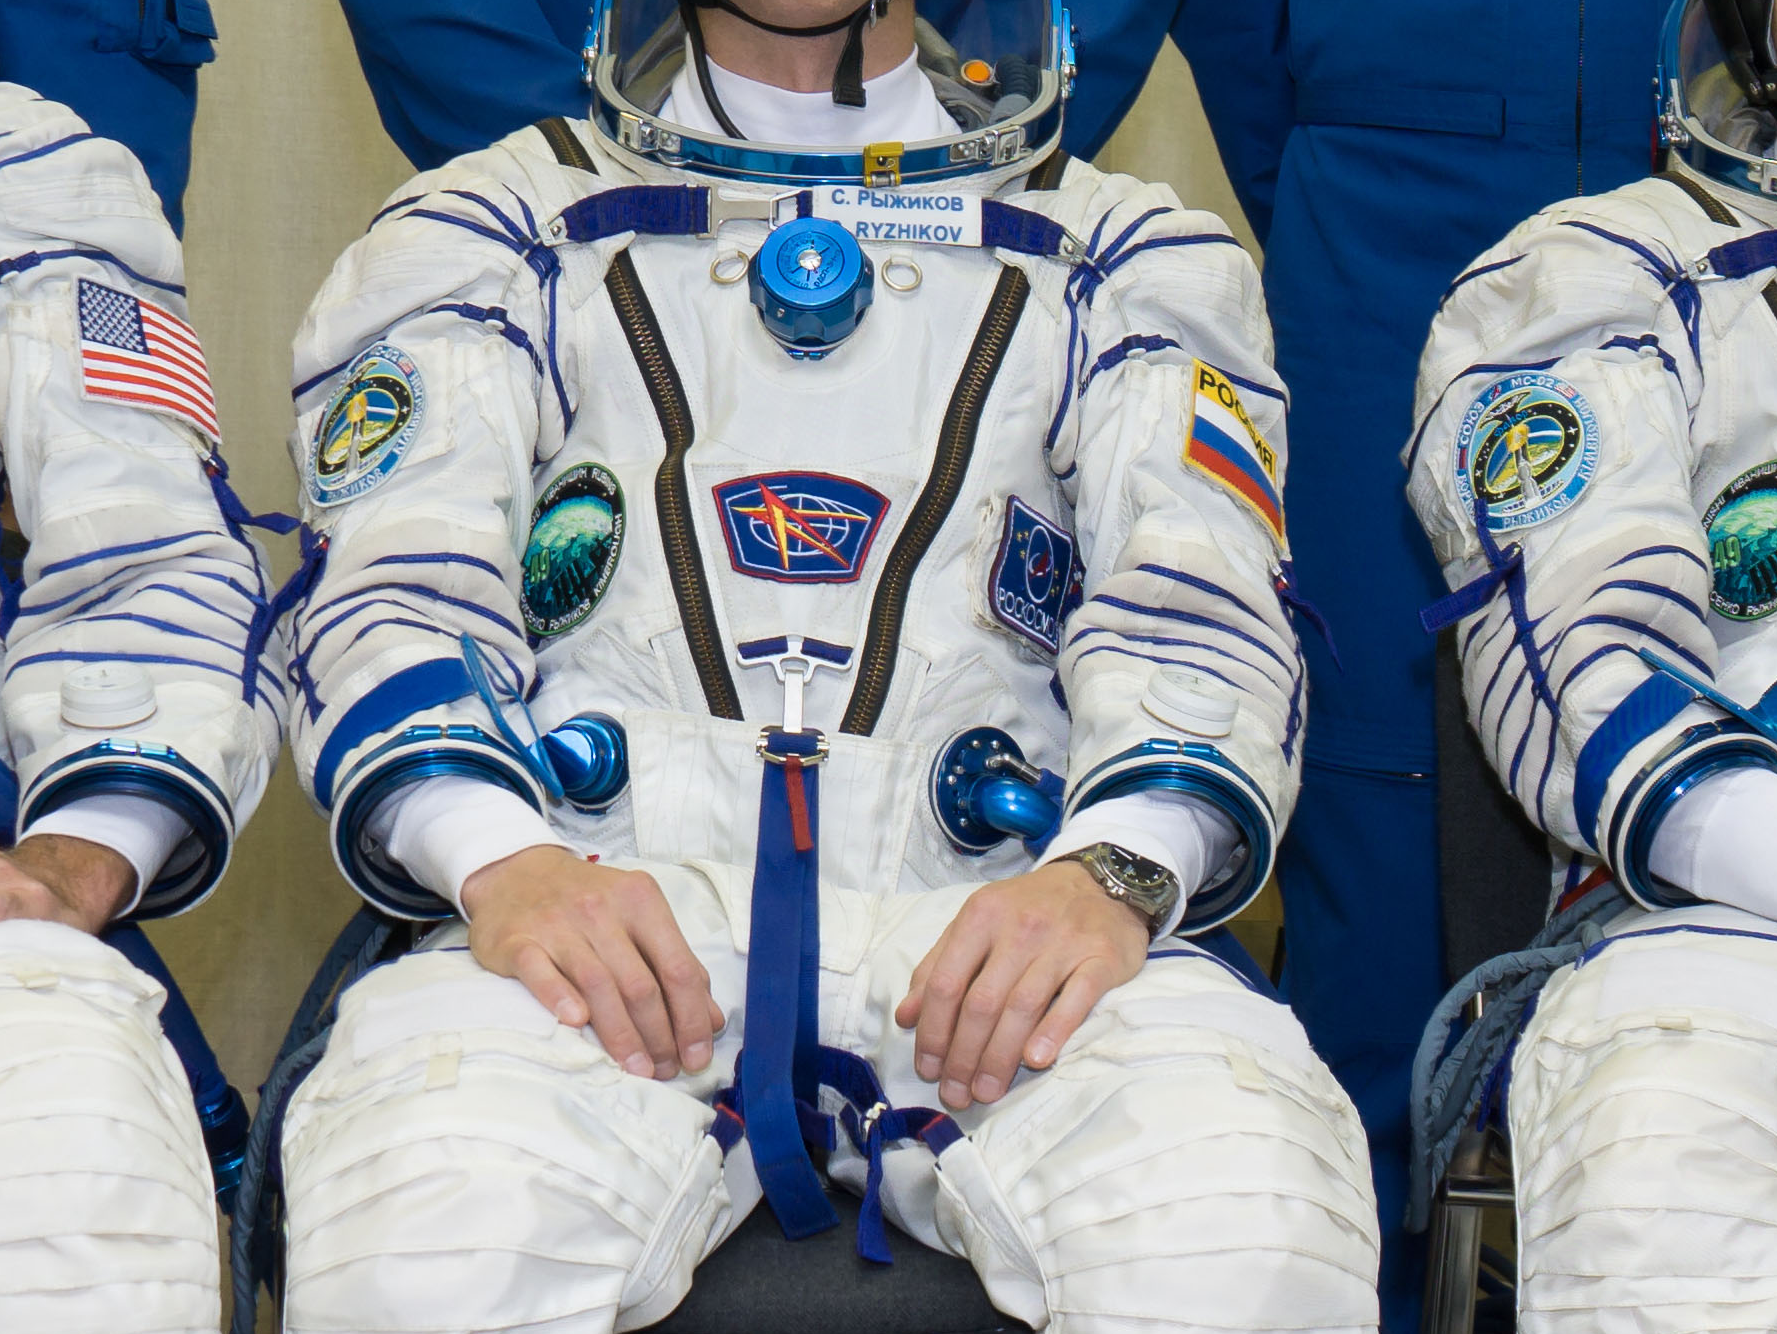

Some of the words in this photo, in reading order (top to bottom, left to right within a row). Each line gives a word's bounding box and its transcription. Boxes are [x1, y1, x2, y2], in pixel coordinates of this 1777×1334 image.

[832, 188, 850, 205] С.
[858, 190, 964, 211] РЫЖИКОВ
[856, 221, 963, 243] RYZHIKOV
[1460, 401, 1485, 445] СОЮЗ
[1510, 375, 1555, 388] МС-02
